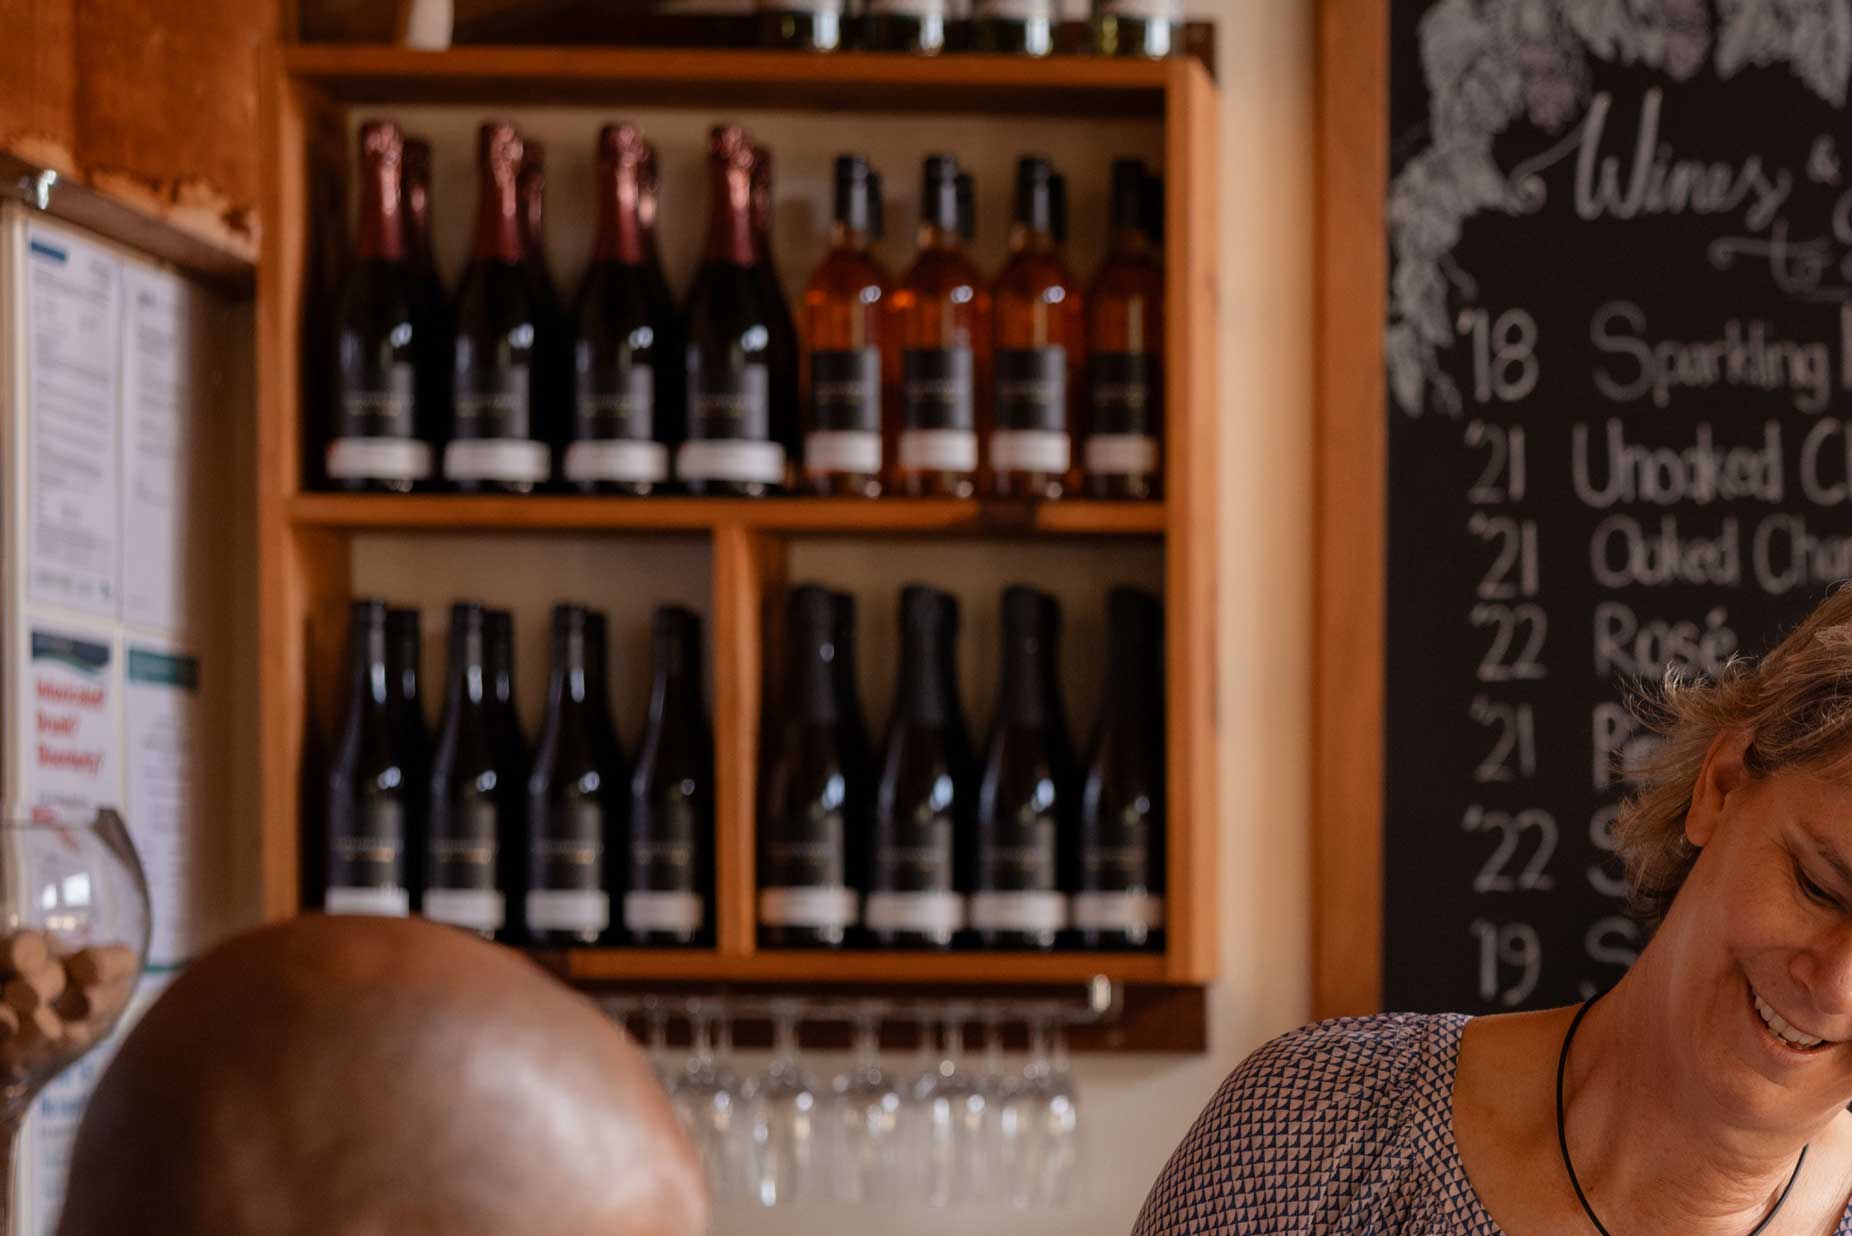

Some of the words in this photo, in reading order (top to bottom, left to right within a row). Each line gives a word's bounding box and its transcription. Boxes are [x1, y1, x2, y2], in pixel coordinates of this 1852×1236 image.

[1505, 88, 1793, 230] Wines
[1808, 134, 1841, 184] &
[1590, 301, 1830, 413] Sparkling
[1572, 416, 1784, 507] Unoaked
[1589, 513, 1740, 588] Oaked
[1592, 601, 1738, 680] Rosé
